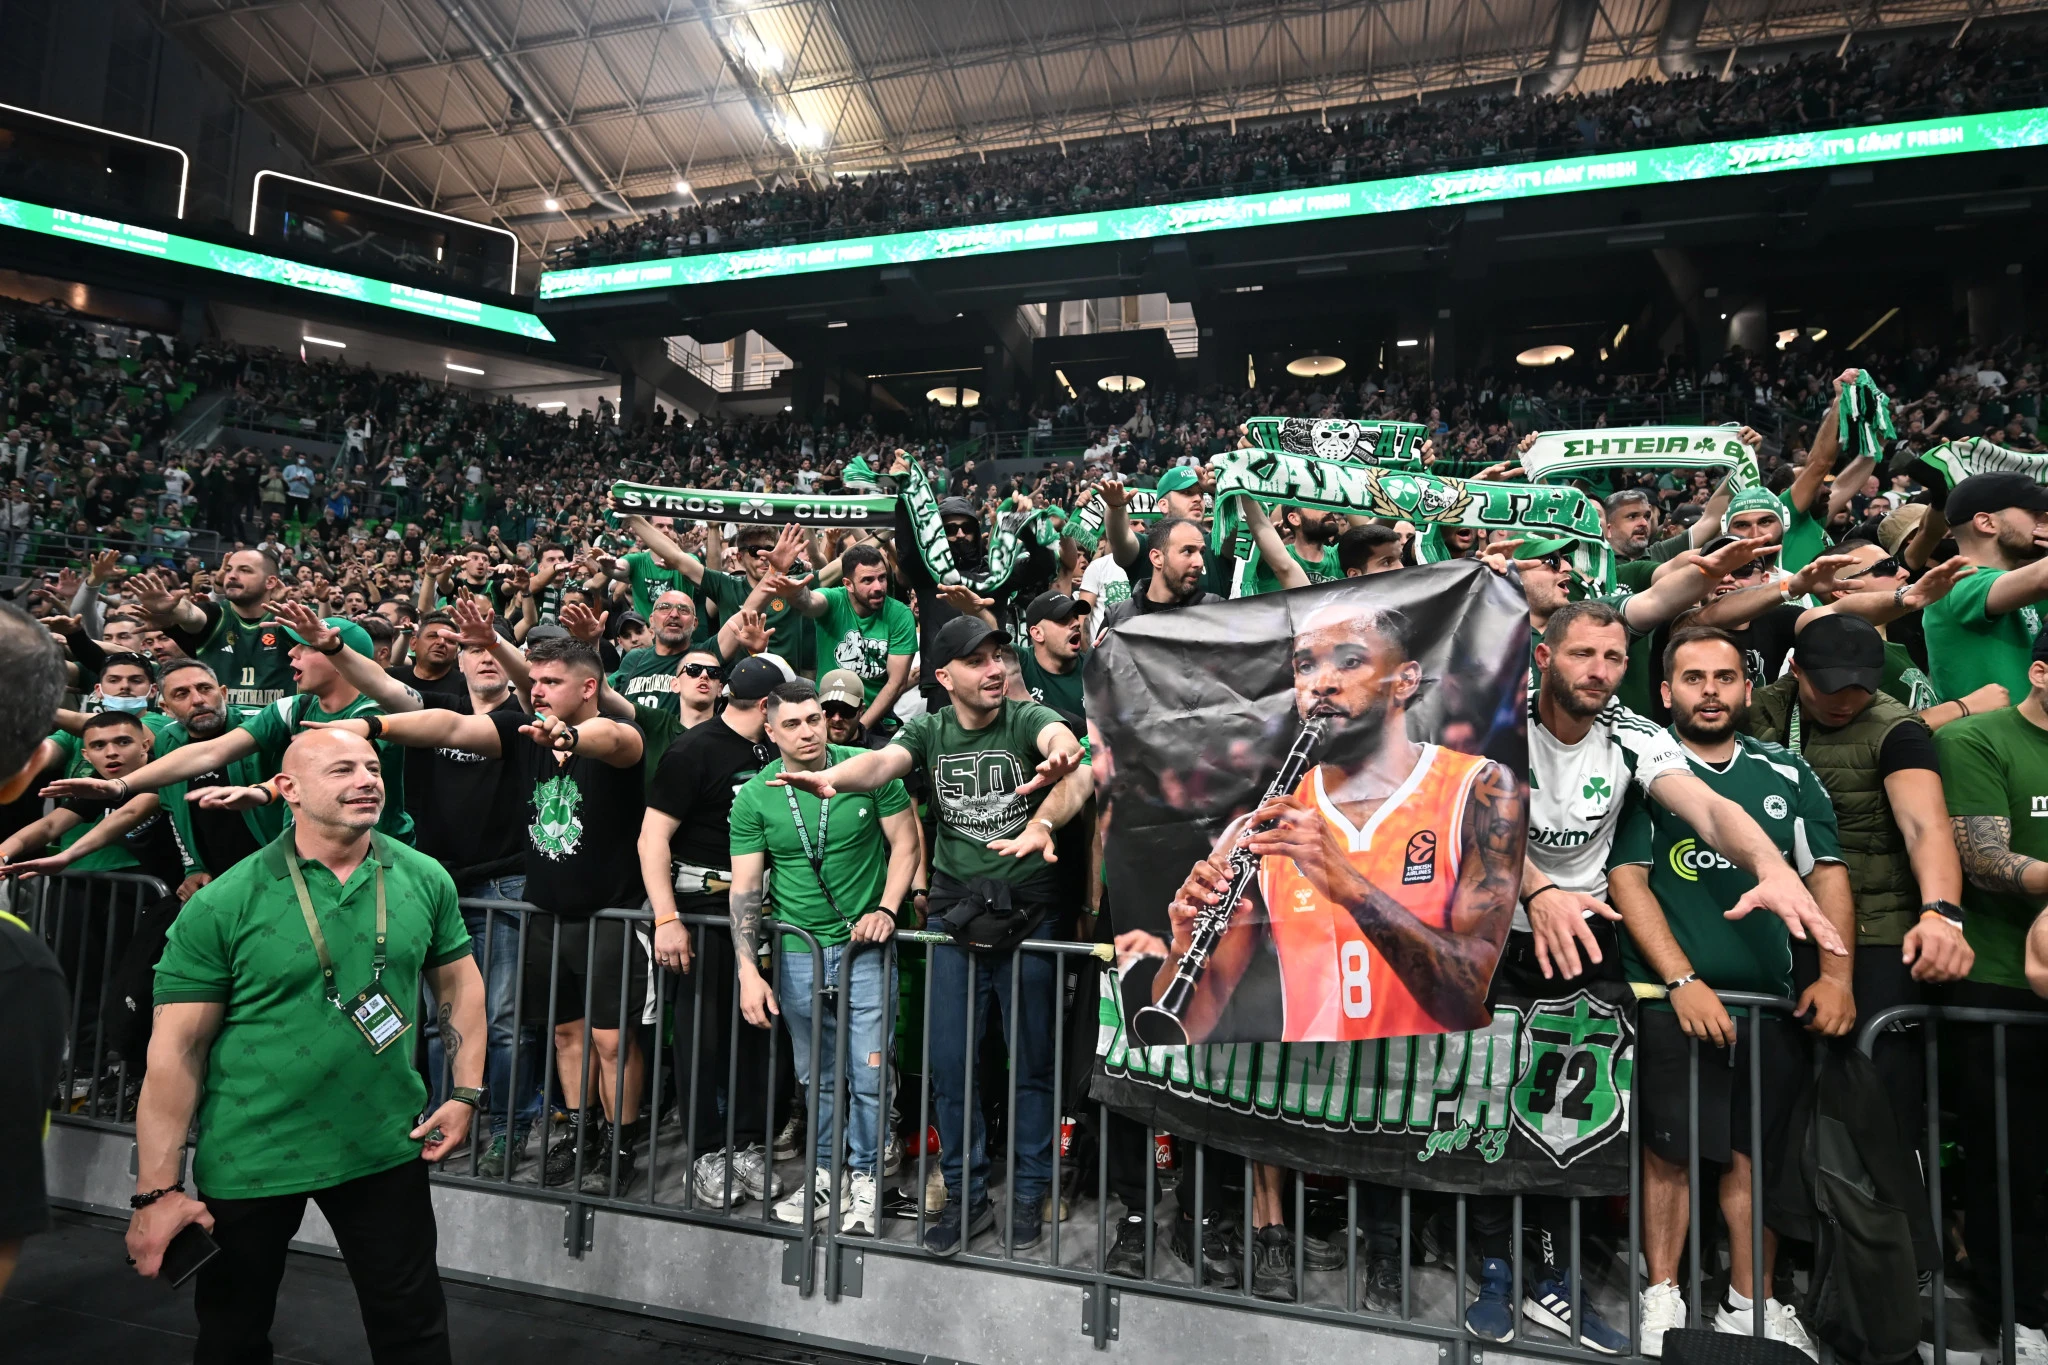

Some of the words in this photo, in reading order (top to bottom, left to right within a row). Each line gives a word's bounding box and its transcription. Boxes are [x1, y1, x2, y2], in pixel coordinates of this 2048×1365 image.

[1727, 140, 1813, 168] Sprite
[1823, 137, 1854, 155] IT'S
[1907, 126, 1963, 147] FRESH
[1430, 172, 1506, 199] Sprite
[1514, 170, 1540, 187] IT'S
[1587, 160, 1637, 181] FRESH
[1168, 204, 1236, 228] Sprite
[935, 231, 998, 252] Sprite
[1374, 426, 1428, 458] AT
[1563, 436, 1689, 458] ΣΗΤΕΙΑ
[622, 491, 724, 514] SYROS
[793, 503, 868, 519] CLUB
[240, 667, 255, 686] 11
[797, 826, 814, 859] WORLD
[1405, 869, 1432, 877] AIRLINES
[1406, 863, 1432, 872] TURKISH
[1294, 904, 1316, 912] hummel
[1340, 940, 1372, 1019] 8
[1528, 1051, 1597, 1120] 92
[1417, 1120, 1471, 1161] gate
[1475, 1129, 1509, 1162] 13
